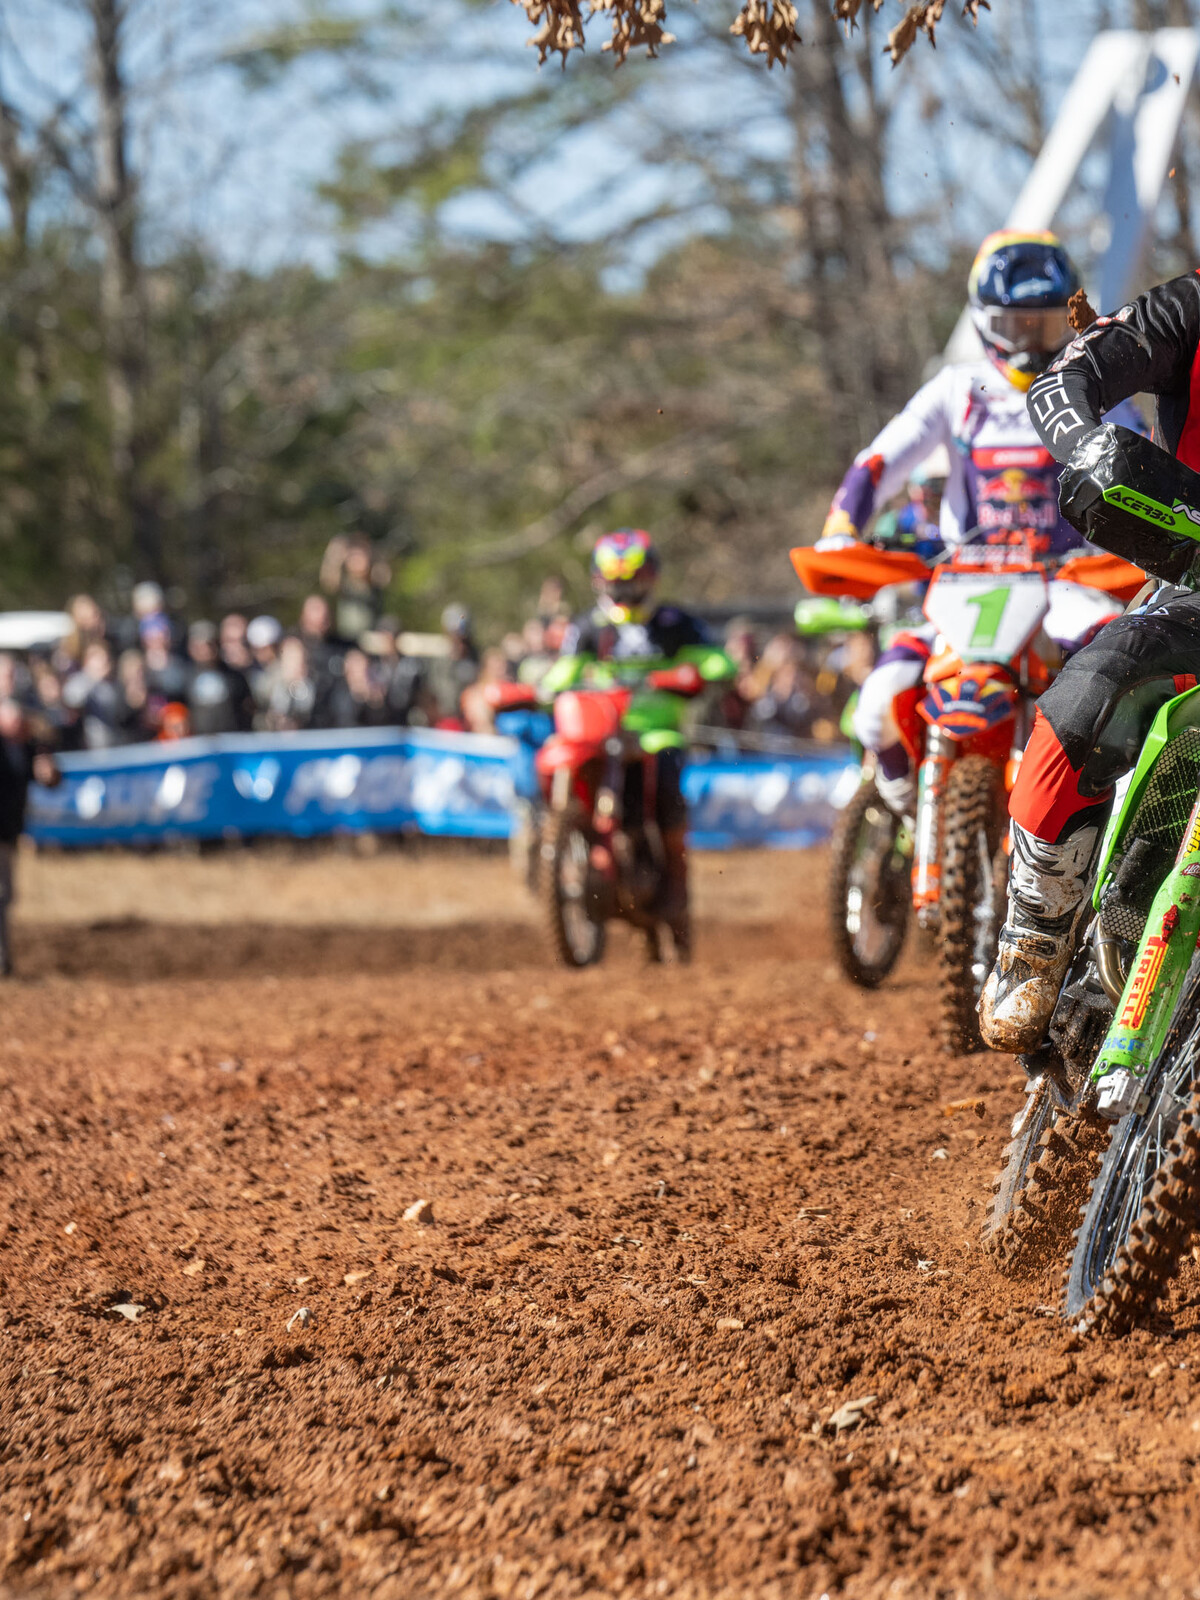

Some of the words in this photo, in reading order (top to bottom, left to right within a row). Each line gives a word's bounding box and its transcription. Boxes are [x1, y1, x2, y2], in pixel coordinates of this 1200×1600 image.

[1108, 491, 1176, 527] ACERBIS
[966, 585, 1011, 648] 1
[1117, 936, 1168, 1030] PIRELLI
